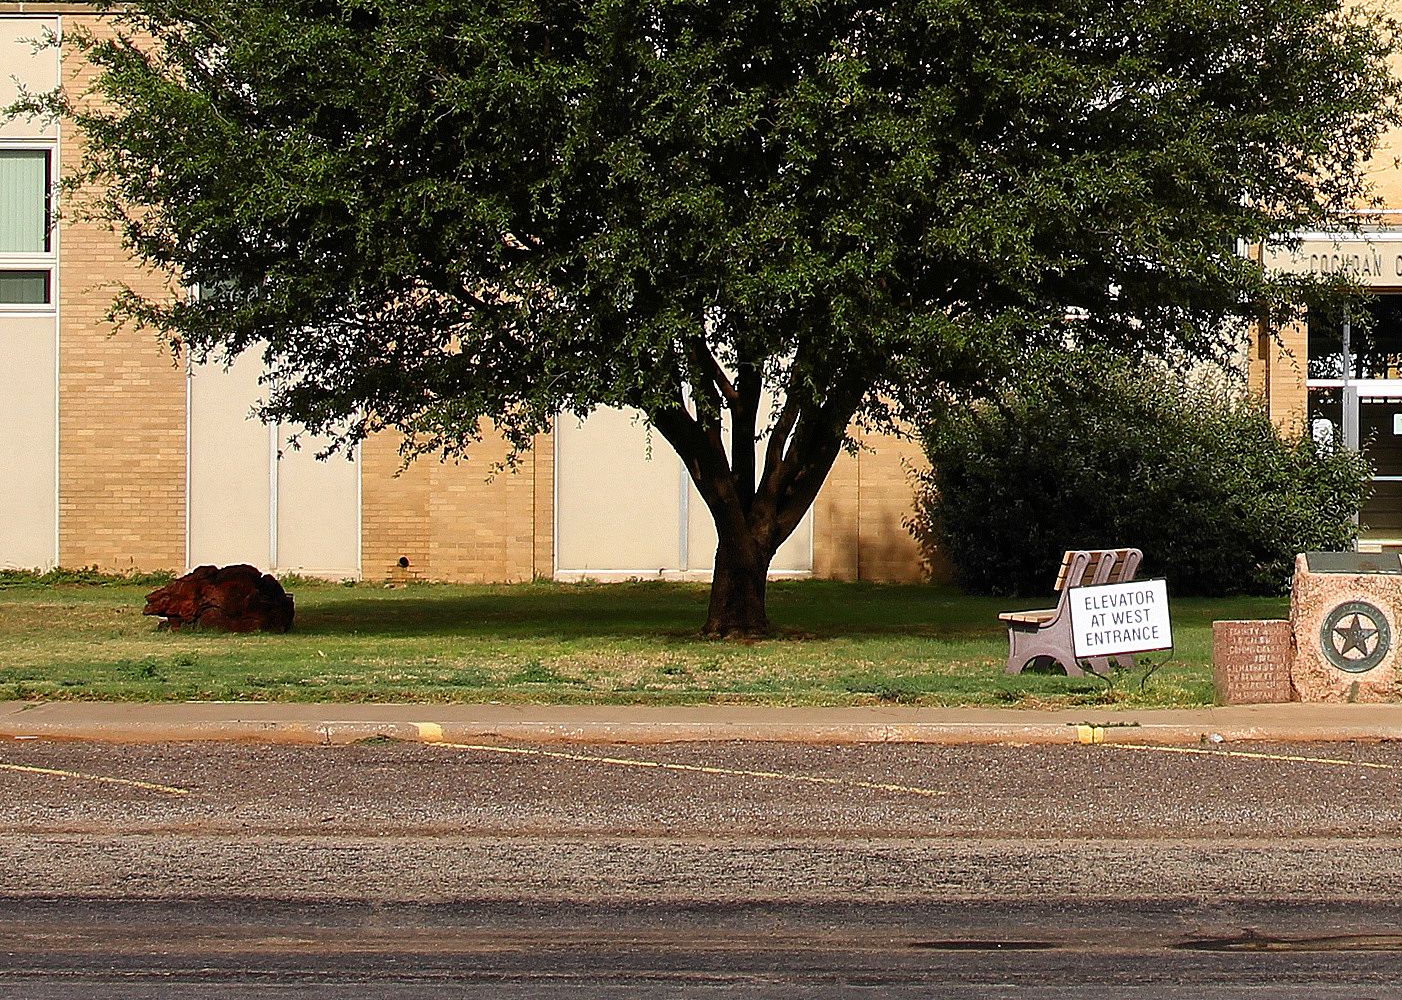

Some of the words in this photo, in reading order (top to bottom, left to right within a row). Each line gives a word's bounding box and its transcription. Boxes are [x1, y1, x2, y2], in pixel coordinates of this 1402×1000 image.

[1310, 254, 1381, 276] COCHRAN
[1084, 590, 1155, 610] ELEVATOR
[1091, 613, 1106, 627] AT
[1112, 608, 1150, 625] WEST
[1085, 625, 1159, 646] ENTRANCE
